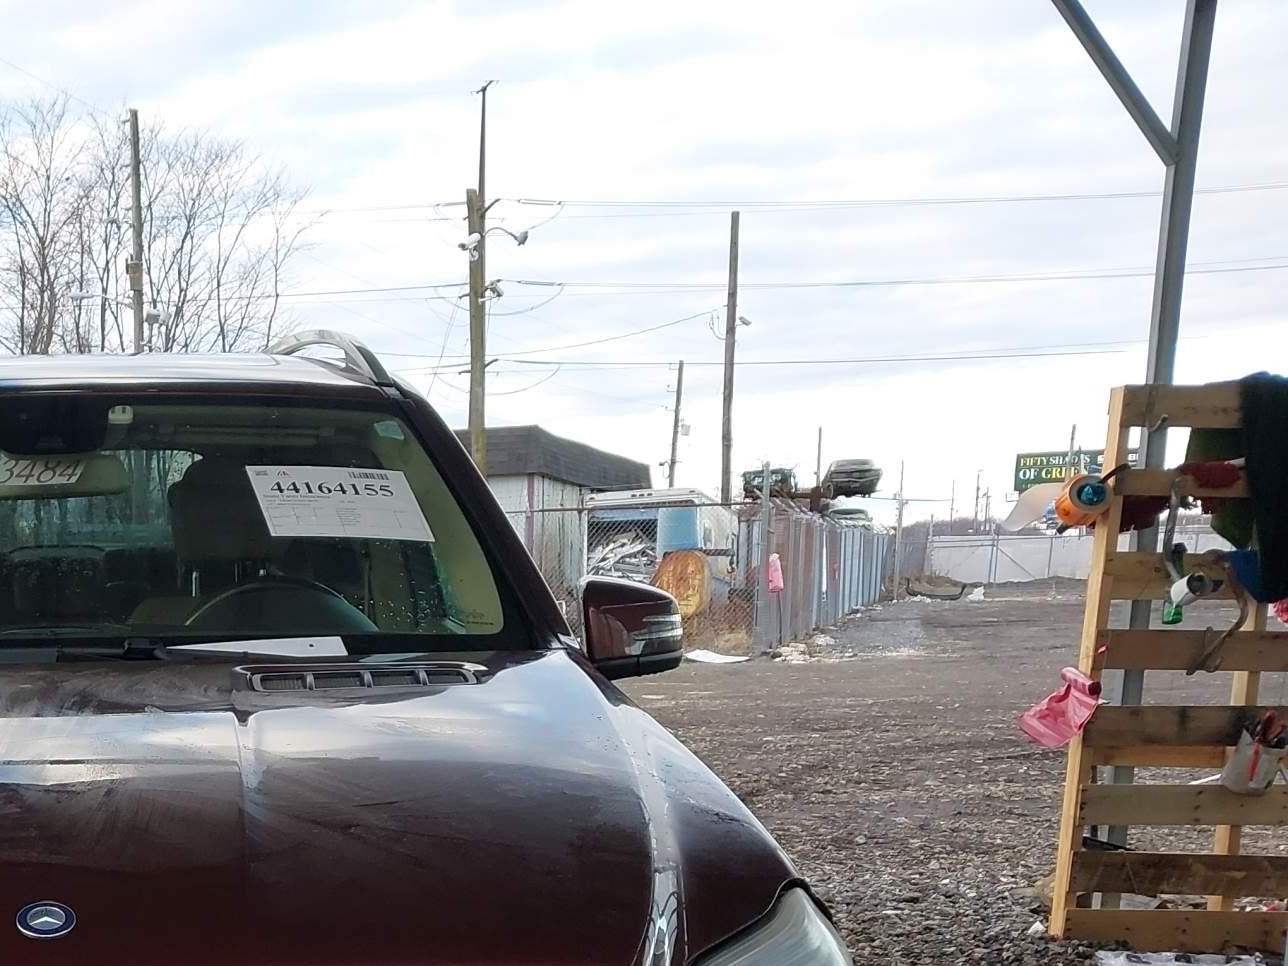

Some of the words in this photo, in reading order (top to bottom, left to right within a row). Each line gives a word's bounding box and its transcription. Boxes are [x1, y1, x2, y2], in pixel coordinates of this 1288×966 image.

[1020, 456, 1049, 466] FIFTY
[1019, 467, 1039, 480] OF
[269, 480, 394, 498] 44164155
